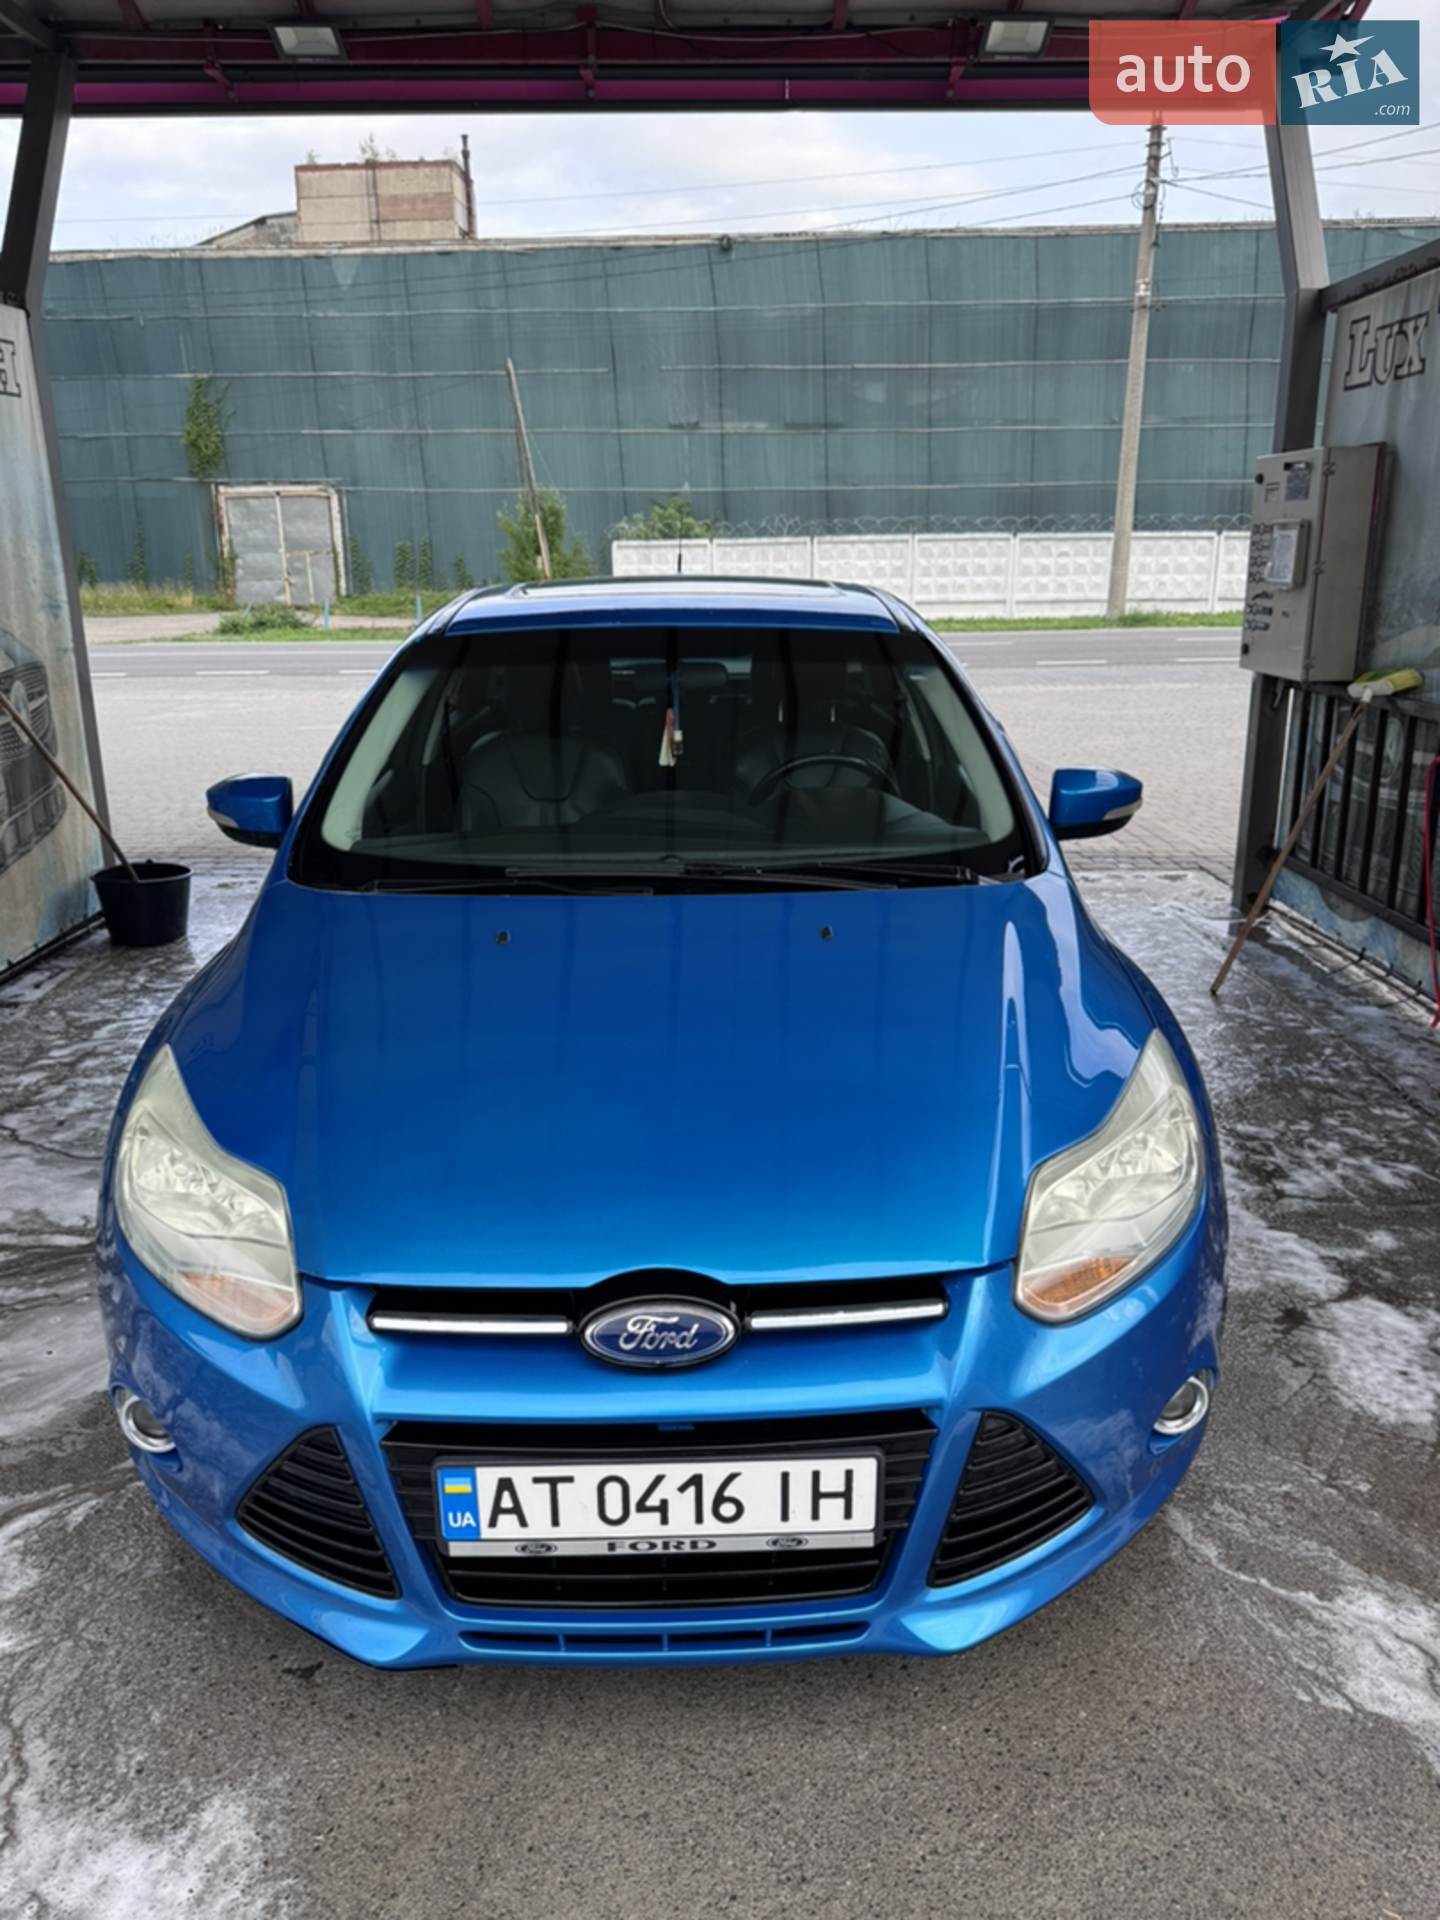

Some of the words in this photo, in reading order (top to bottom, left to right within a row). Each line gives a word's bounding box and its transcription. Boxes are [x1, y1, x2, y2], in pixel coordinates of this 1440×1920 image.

[618, 1315, 700, 1351] Ford
[487, 1475, 575, 1528] AT
[596, 1471, 745, 1527] 0416
[779, 1469, 855, 1523] IH
[448, 1511, 477, 1528] UA
[606, 1539, 718, 1553] FORD
